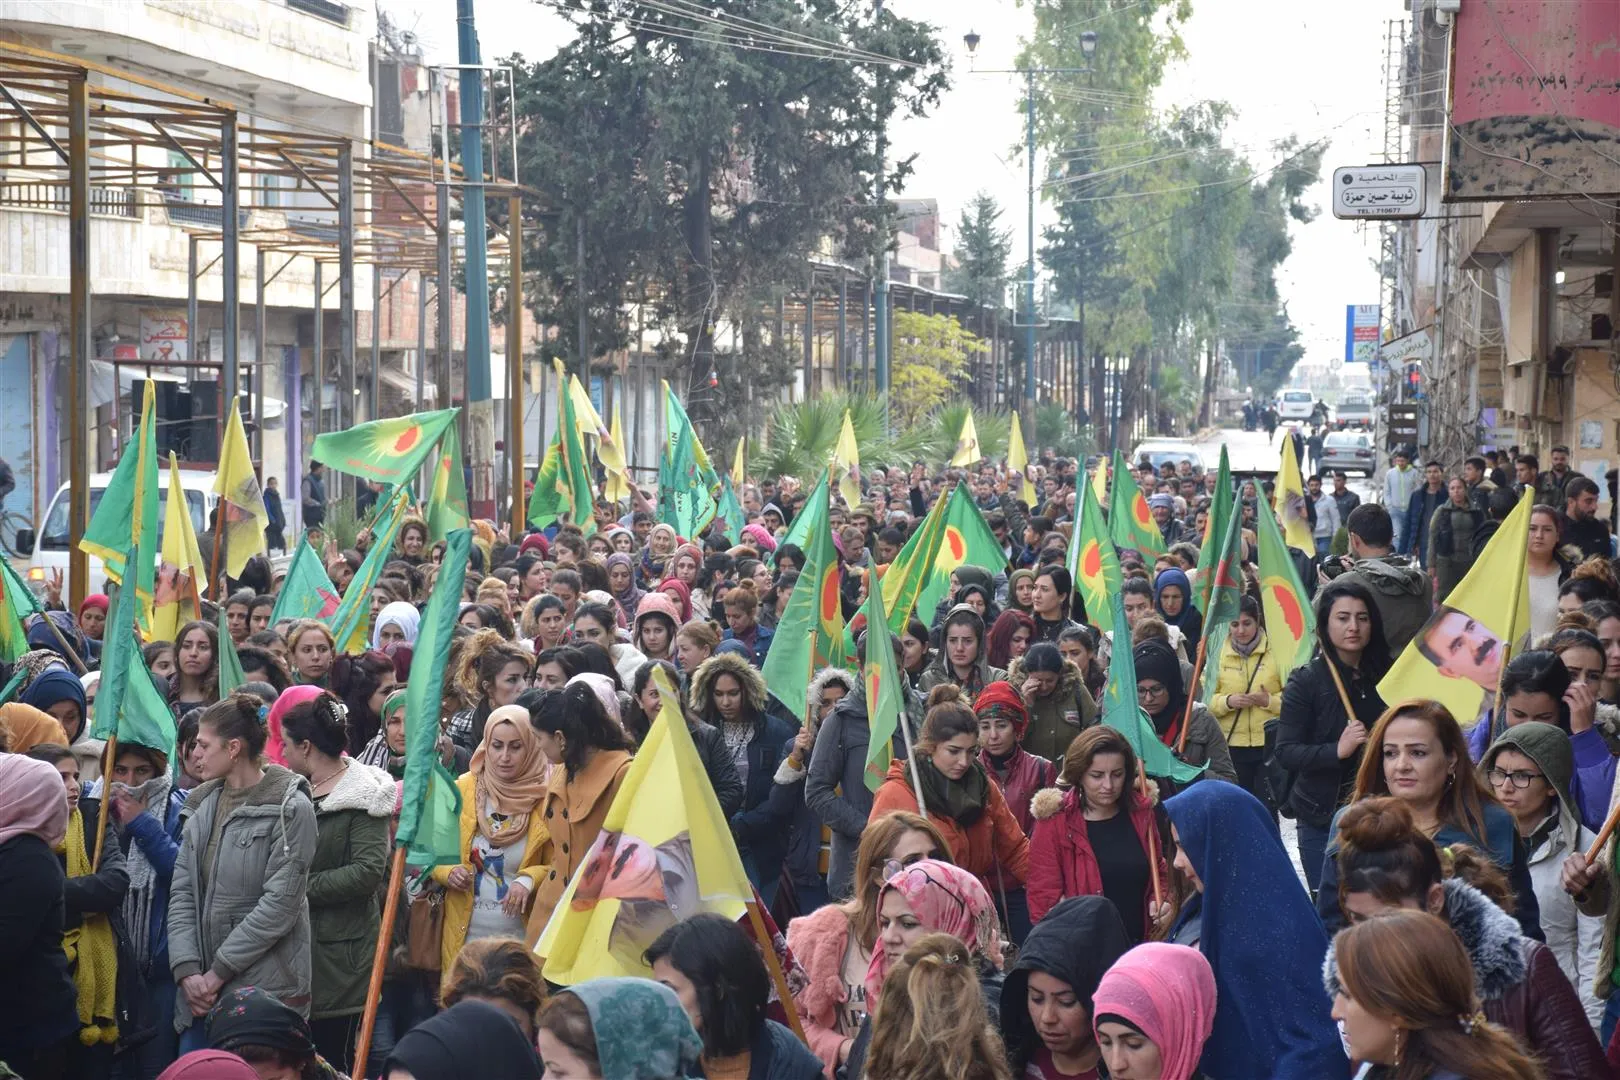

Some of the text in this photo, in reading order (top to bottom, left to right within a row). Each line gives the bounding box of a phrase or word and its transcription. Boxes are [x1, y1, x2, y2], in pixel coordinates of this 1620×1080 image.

[1359, 174, 1398, 184] المحامية
[1345, 193, 1365, 204] حمزة
[1368, 193, 1388, 204] حسين
